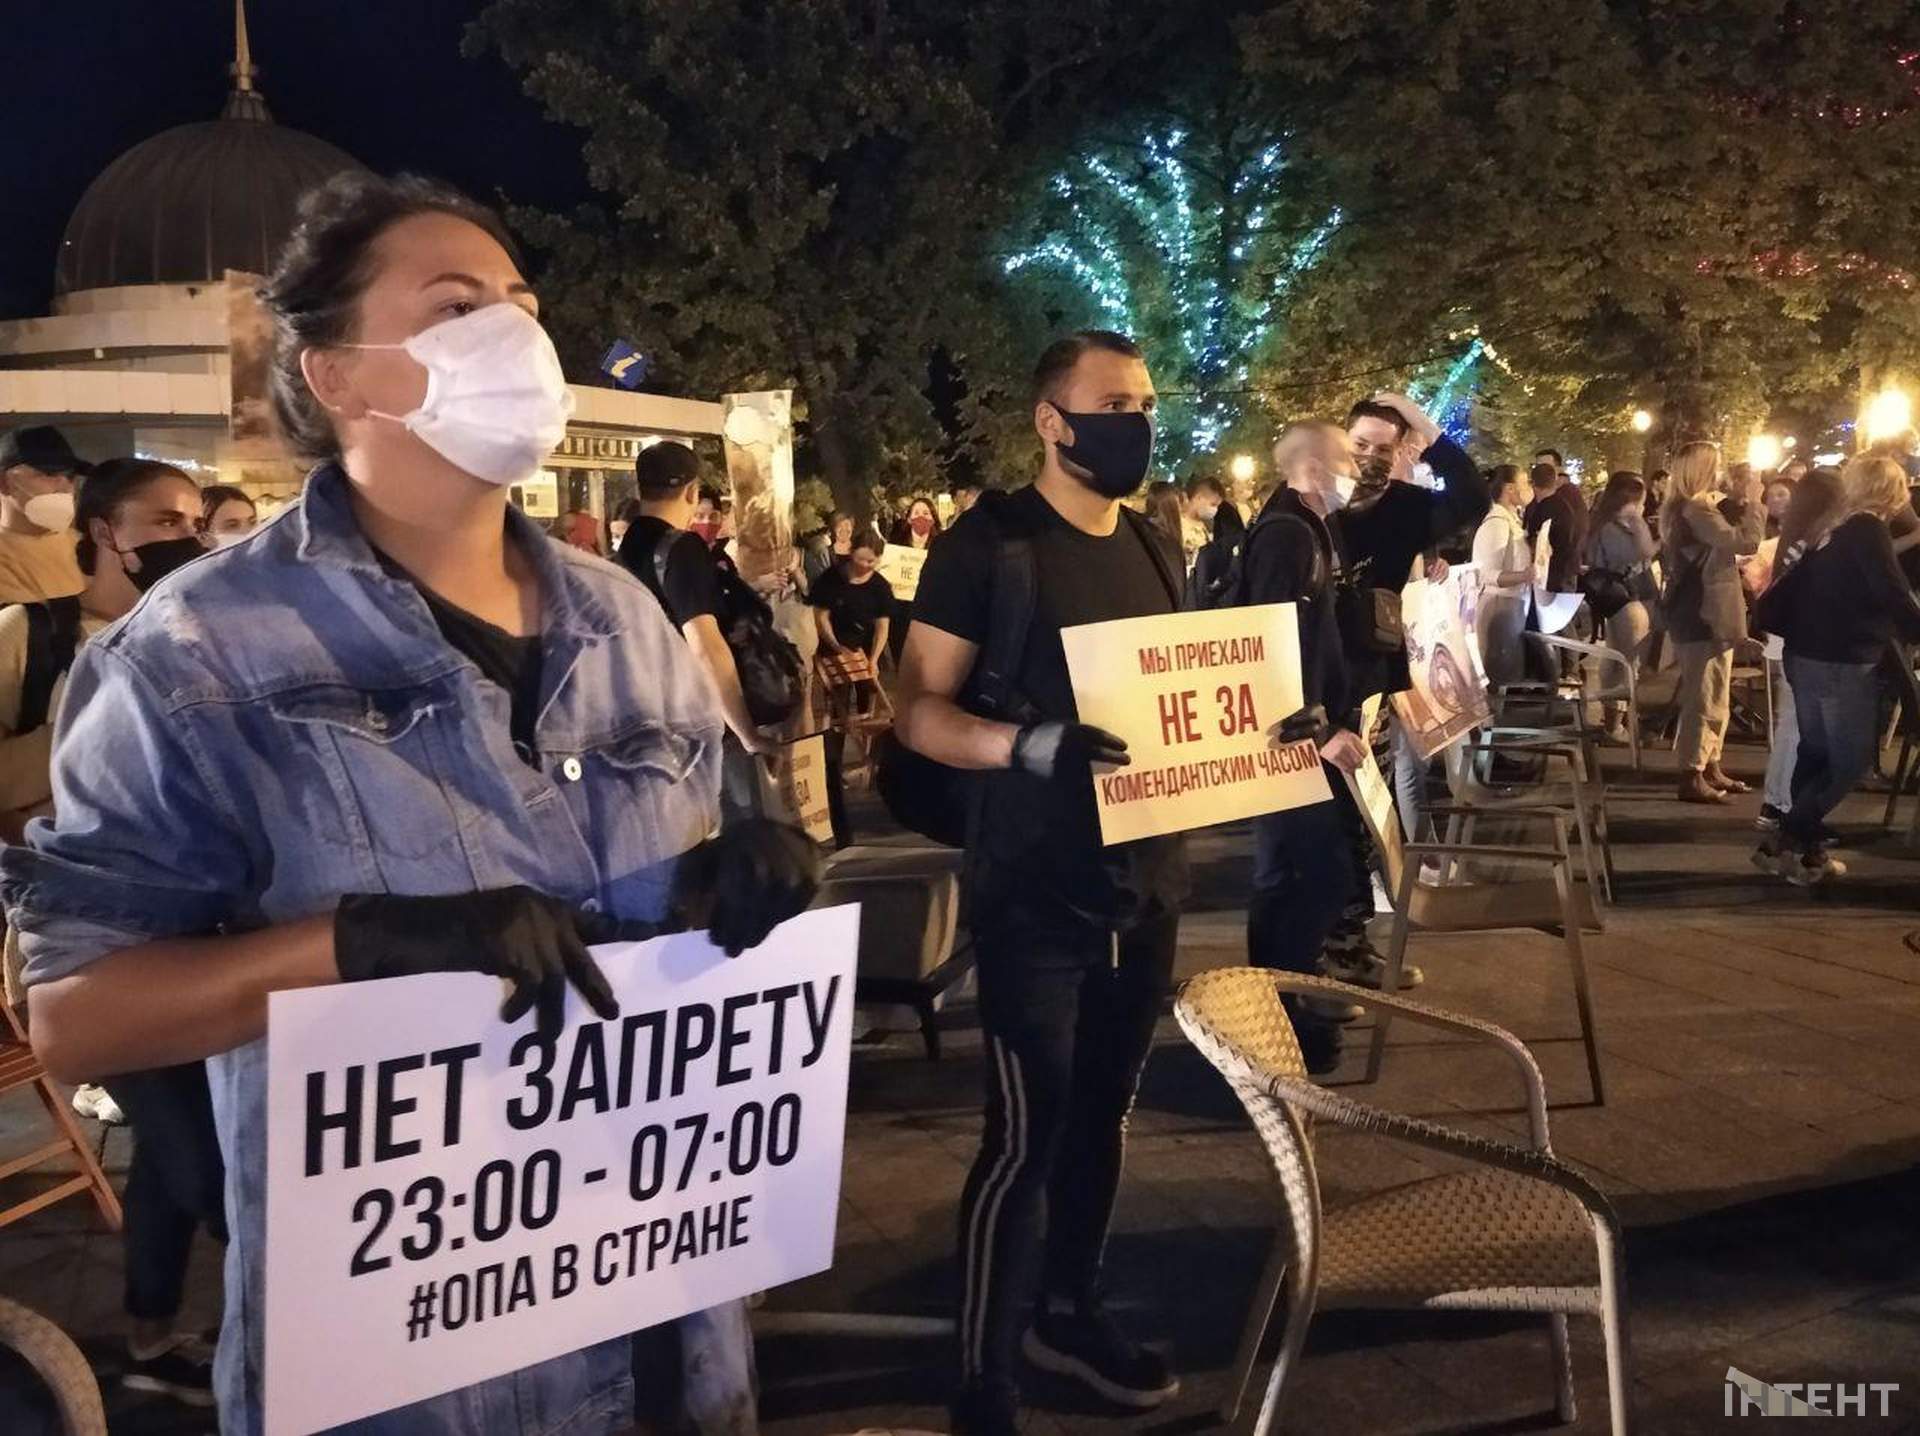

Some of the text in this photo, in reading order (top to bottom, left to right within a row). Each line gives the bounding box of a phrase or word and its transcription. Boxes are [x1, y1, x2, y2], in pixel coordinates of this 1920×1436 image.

[1138, 636, 1265, 675] МЫ ПРИЕХАЛИ
[1157, 683, 1260, 746] НЕ ЗА
[1102, 743, 1320, 806] КОМЕНДАНТСКИМ ЧАСОМ
[303, 974, 843, 1177] НЕТ ЗАПРЕТУ
[349, 1092, 801, 1277] 23:00 - 07:00
[405, 1194, 754, 1343] #ОПА В СТРАНЕ
